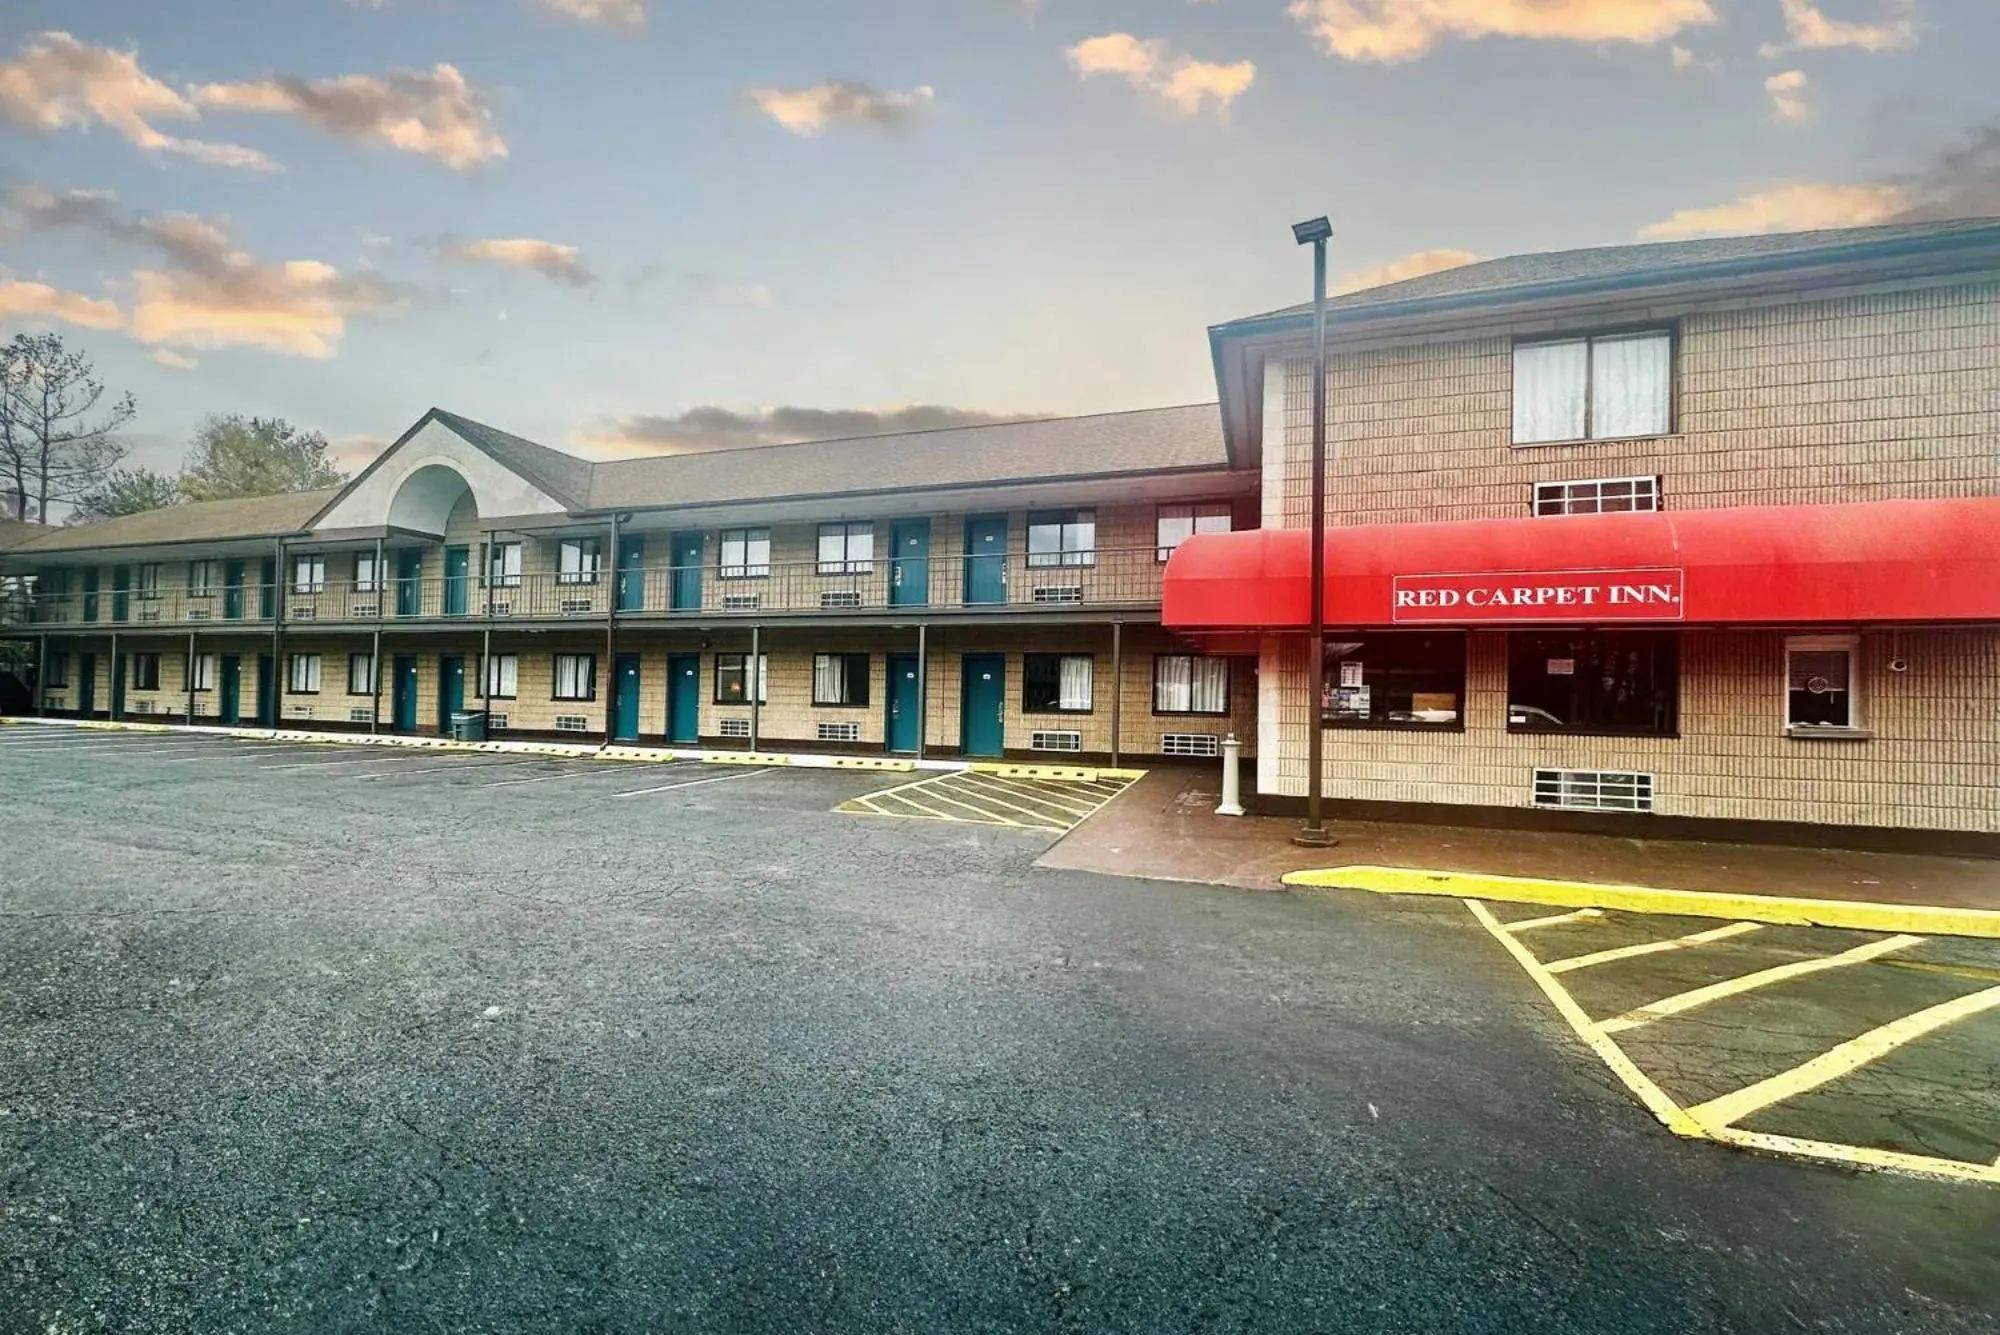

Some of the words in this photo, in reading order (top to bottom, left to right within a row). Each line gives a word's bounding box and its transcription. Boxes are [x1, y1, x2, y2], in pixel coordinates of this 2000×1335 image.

[1396, 589, 1460, 607] RED
[1465, 586, 1600, 607] CARPET
[1607, 585, 1680, 604] INN.
